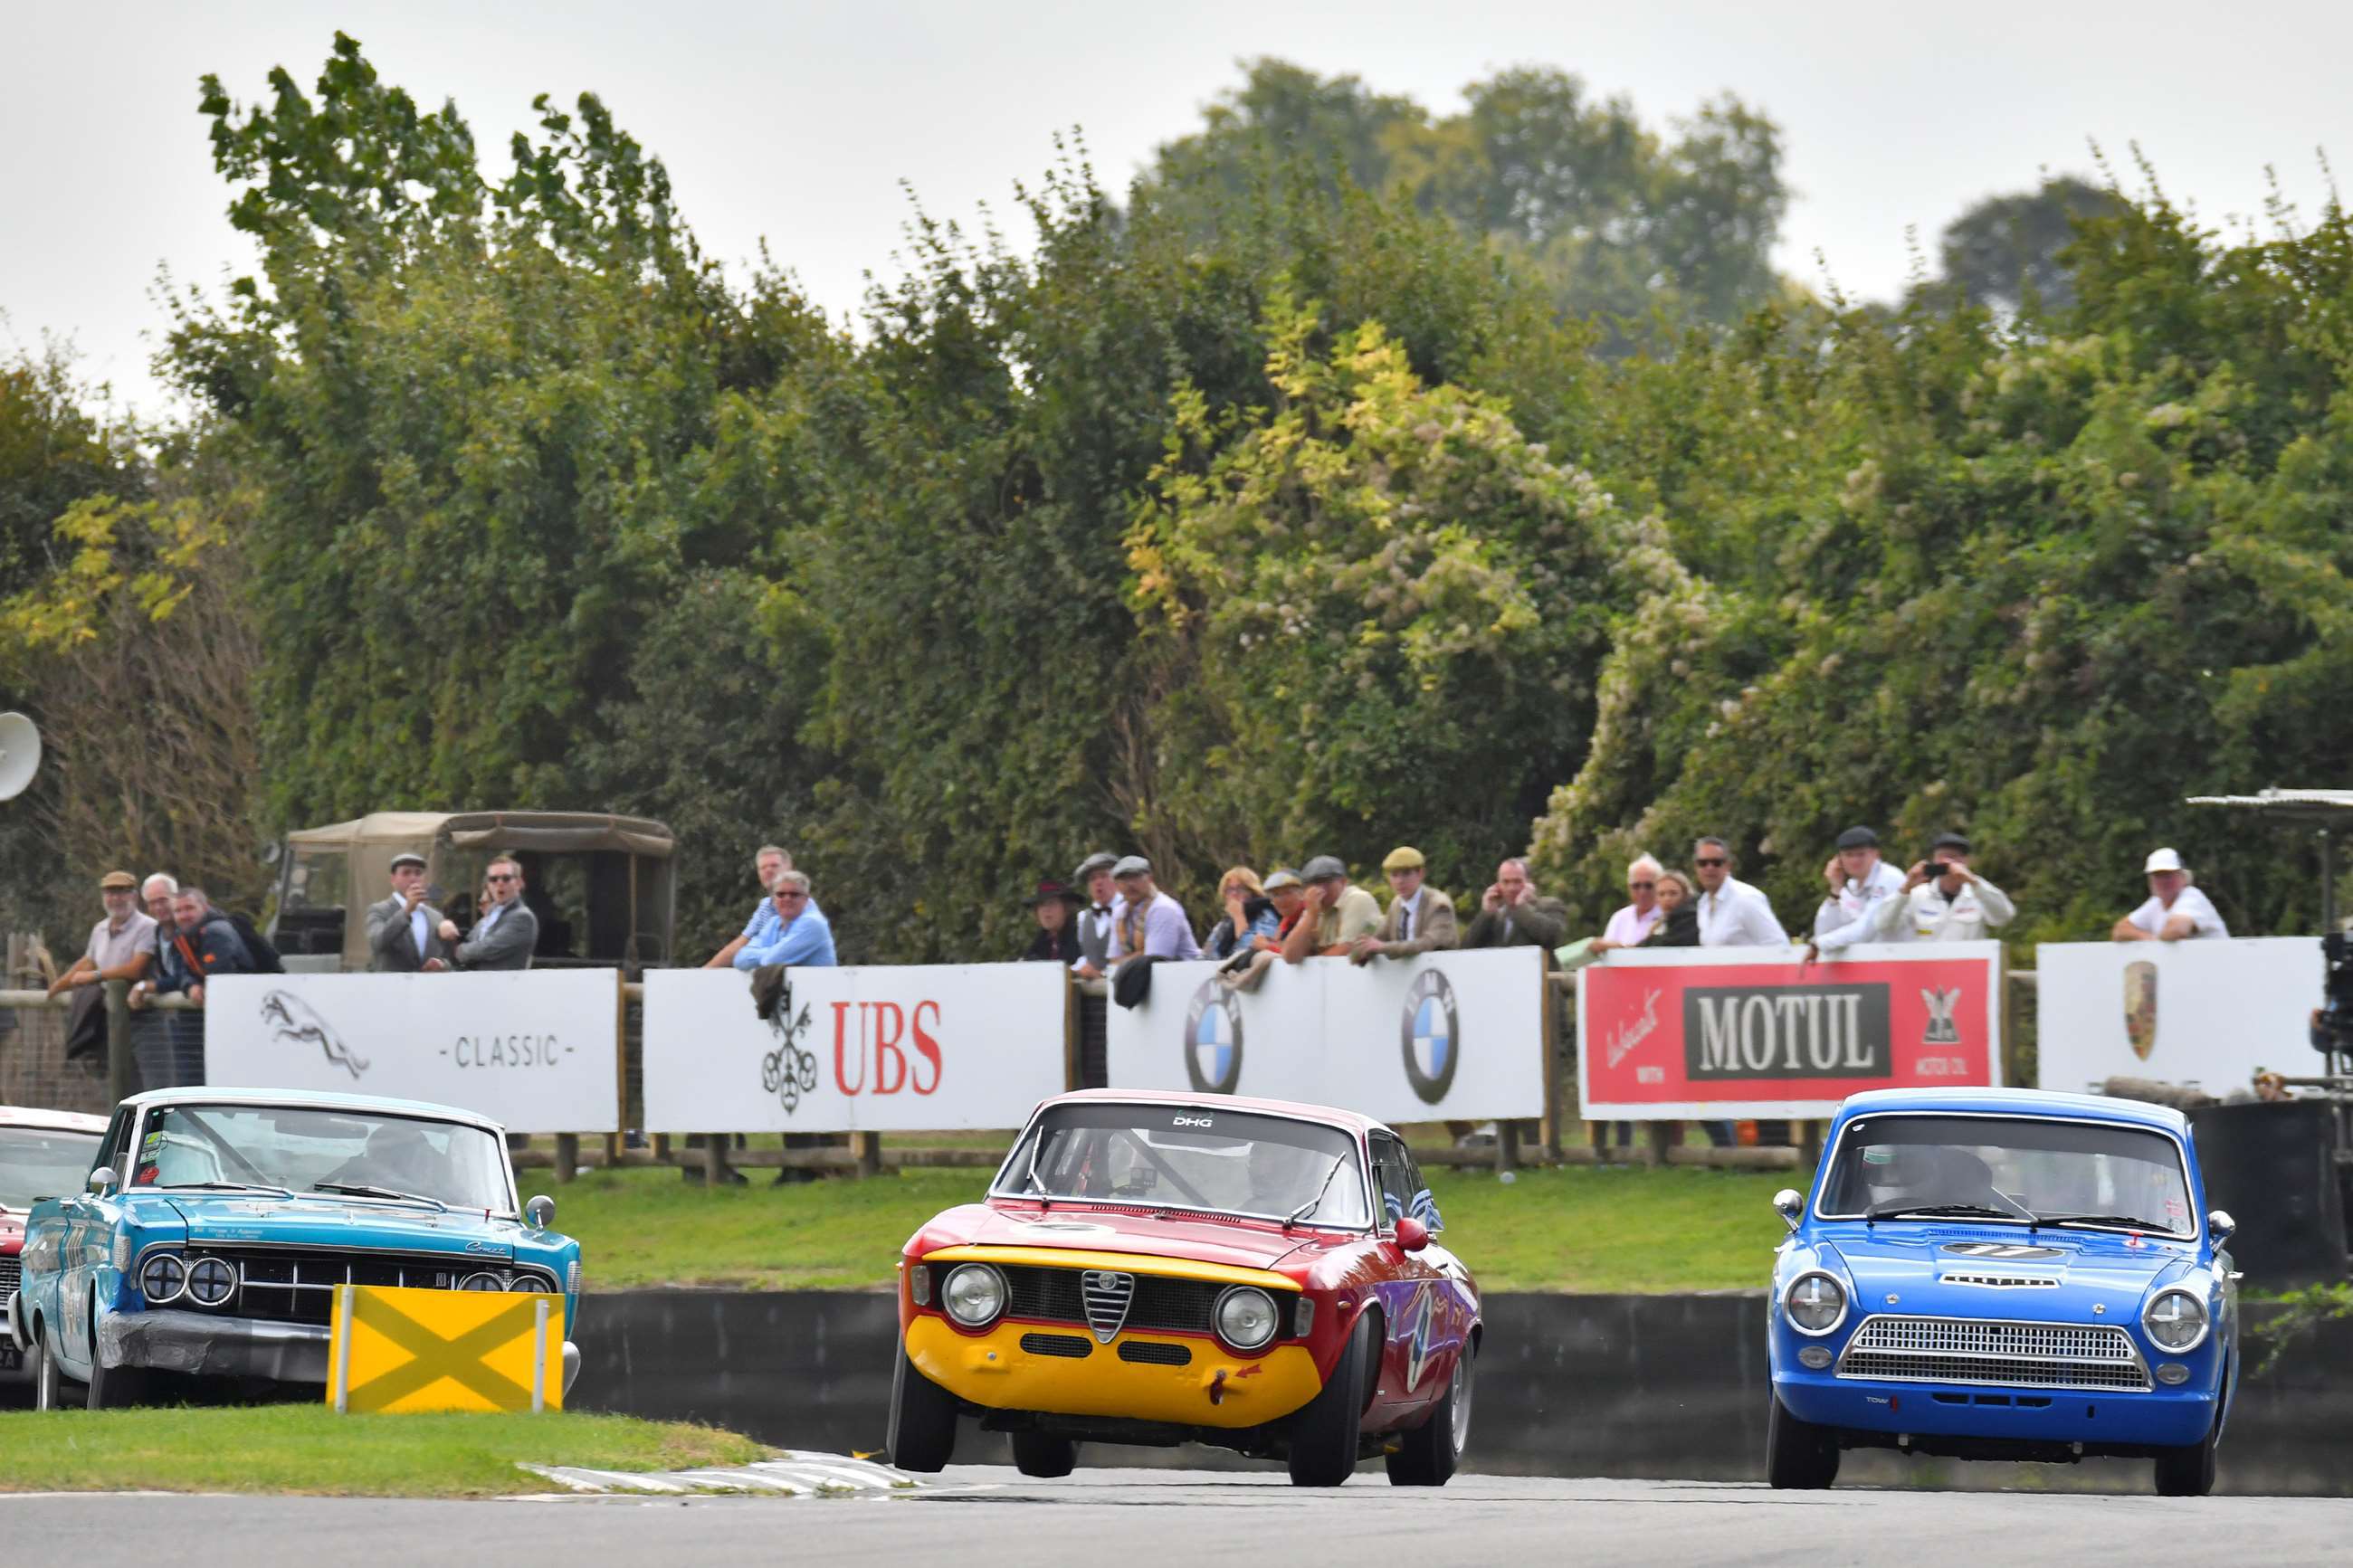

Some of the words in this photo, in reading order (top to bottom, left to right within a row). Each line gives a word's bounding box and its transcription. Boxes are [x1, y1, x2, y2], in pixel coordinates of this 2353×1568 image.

[1698, 994, 1874, 1070] MOTUL
[831, 1000, 942, 1097] UBS
[1173, 1117, 1213, 1127] DHG
[465, 1240, 507, 1254] Comet
[1866, 1396, 1889, 1404] TOW
